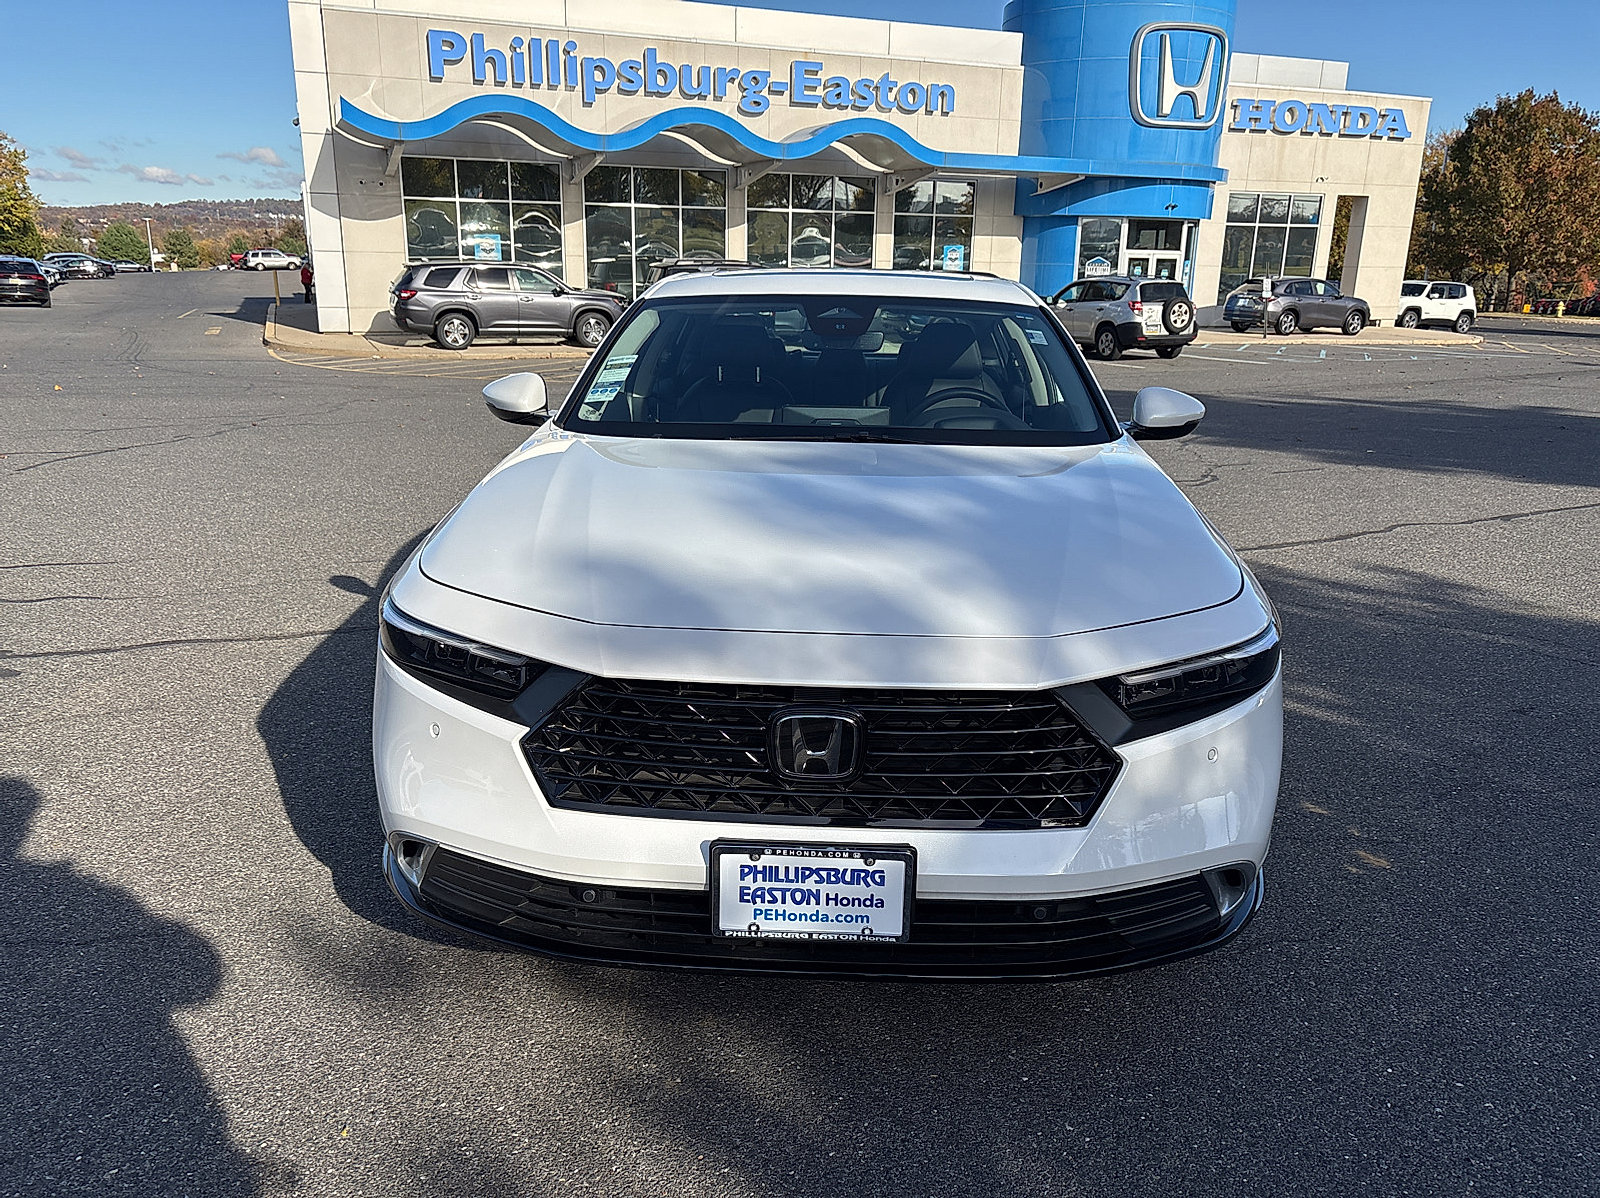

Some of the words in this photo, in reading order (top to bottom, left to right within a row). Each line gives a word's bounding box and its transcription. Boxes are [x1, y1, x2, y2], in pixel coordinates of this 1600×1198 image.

[427, 28, 956, 115] Phillipsburg-Easton
[1230, 97, 1412, 140] HONDA
[776, 849, 849, 858] PEHONDA.COM
[739, 865, 885, 888] PHILLIPSBURG
[738, 886, 821, 906] EASTON
[825, 892, 885, 909] Honda
[754, 908, 869, 923] PEHonda.com
[725, 930, 808, 940] PHILLIPSBURG
[812, 933, 857, 941] EASTON
[859, 935, 896, 943] Honda
